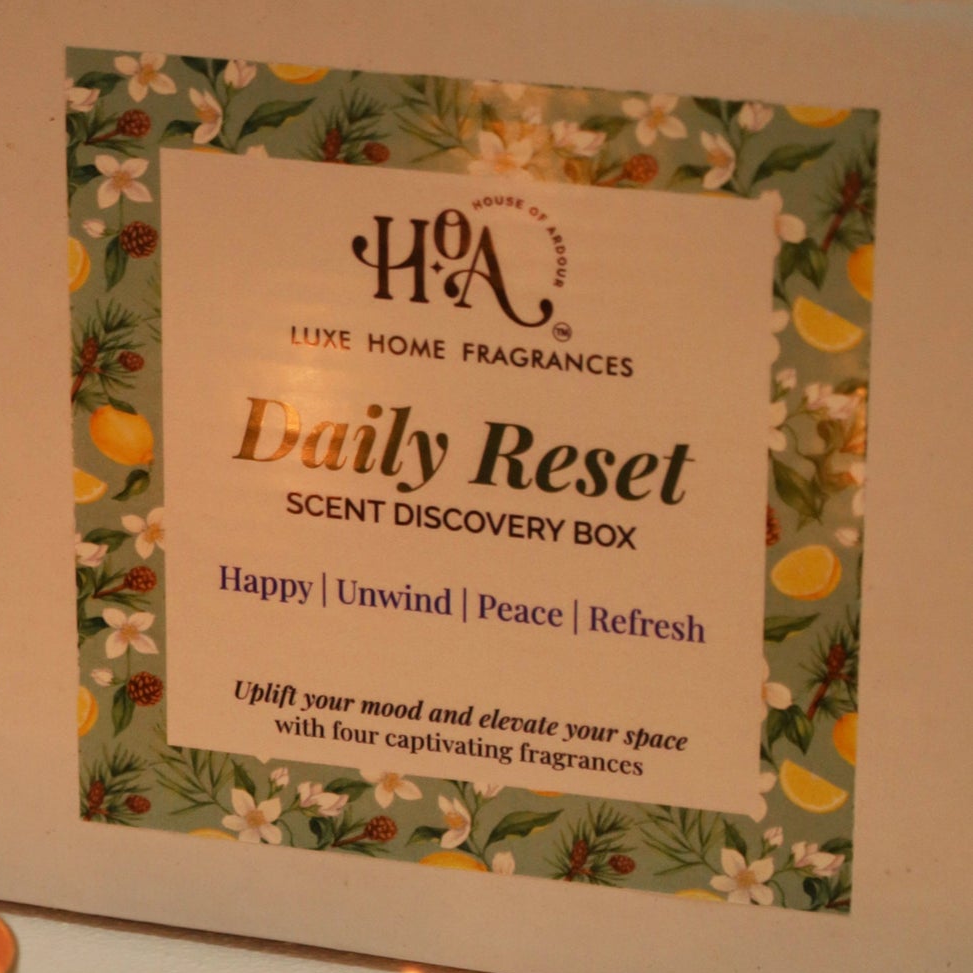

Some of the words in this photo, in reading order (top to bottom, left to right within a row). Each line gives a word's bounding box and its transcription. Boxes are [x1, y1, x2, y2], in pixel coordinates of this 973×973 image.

[472, 196, 525, 211] HOUSE
[529, 206, 548, 222] OF
[546, 226, 568, 288] ARDOUR
[291, 325, 352, 351] LUXE
[368, 333, 446, 360] HOME
[463, 342, 634, 378] FRAGRANCES
[232, 396, 449, 493] Daily
[468, 421, 696, 506] Reset
[286, 492, 386, 523] SCENT
[394, 502, 566, 542] DISCOVERY
[574, 520, 637, 550] BOX
[219, 565, 314, 604] Happy
[336, 578, 453, 615] Unwind
[477, 593, 564, 627] Peace
[589, 605, 707, 644] Refresh
[234, 680, 298, 709] Uplift
[300, 692, 356, 712] your
[360, 699, 425, 721] mood
[428, 706, 474, 727] and
[479, 709, 559, 736] elevate
[561, 722, 619, 743] your
[623, 727, 689, 752] space
[275, 716, 326, 739] with
[331, 720, 380, 745] four
[384, 732, 514, 765] captivating
[519, 742, 644, 777] fragrances
